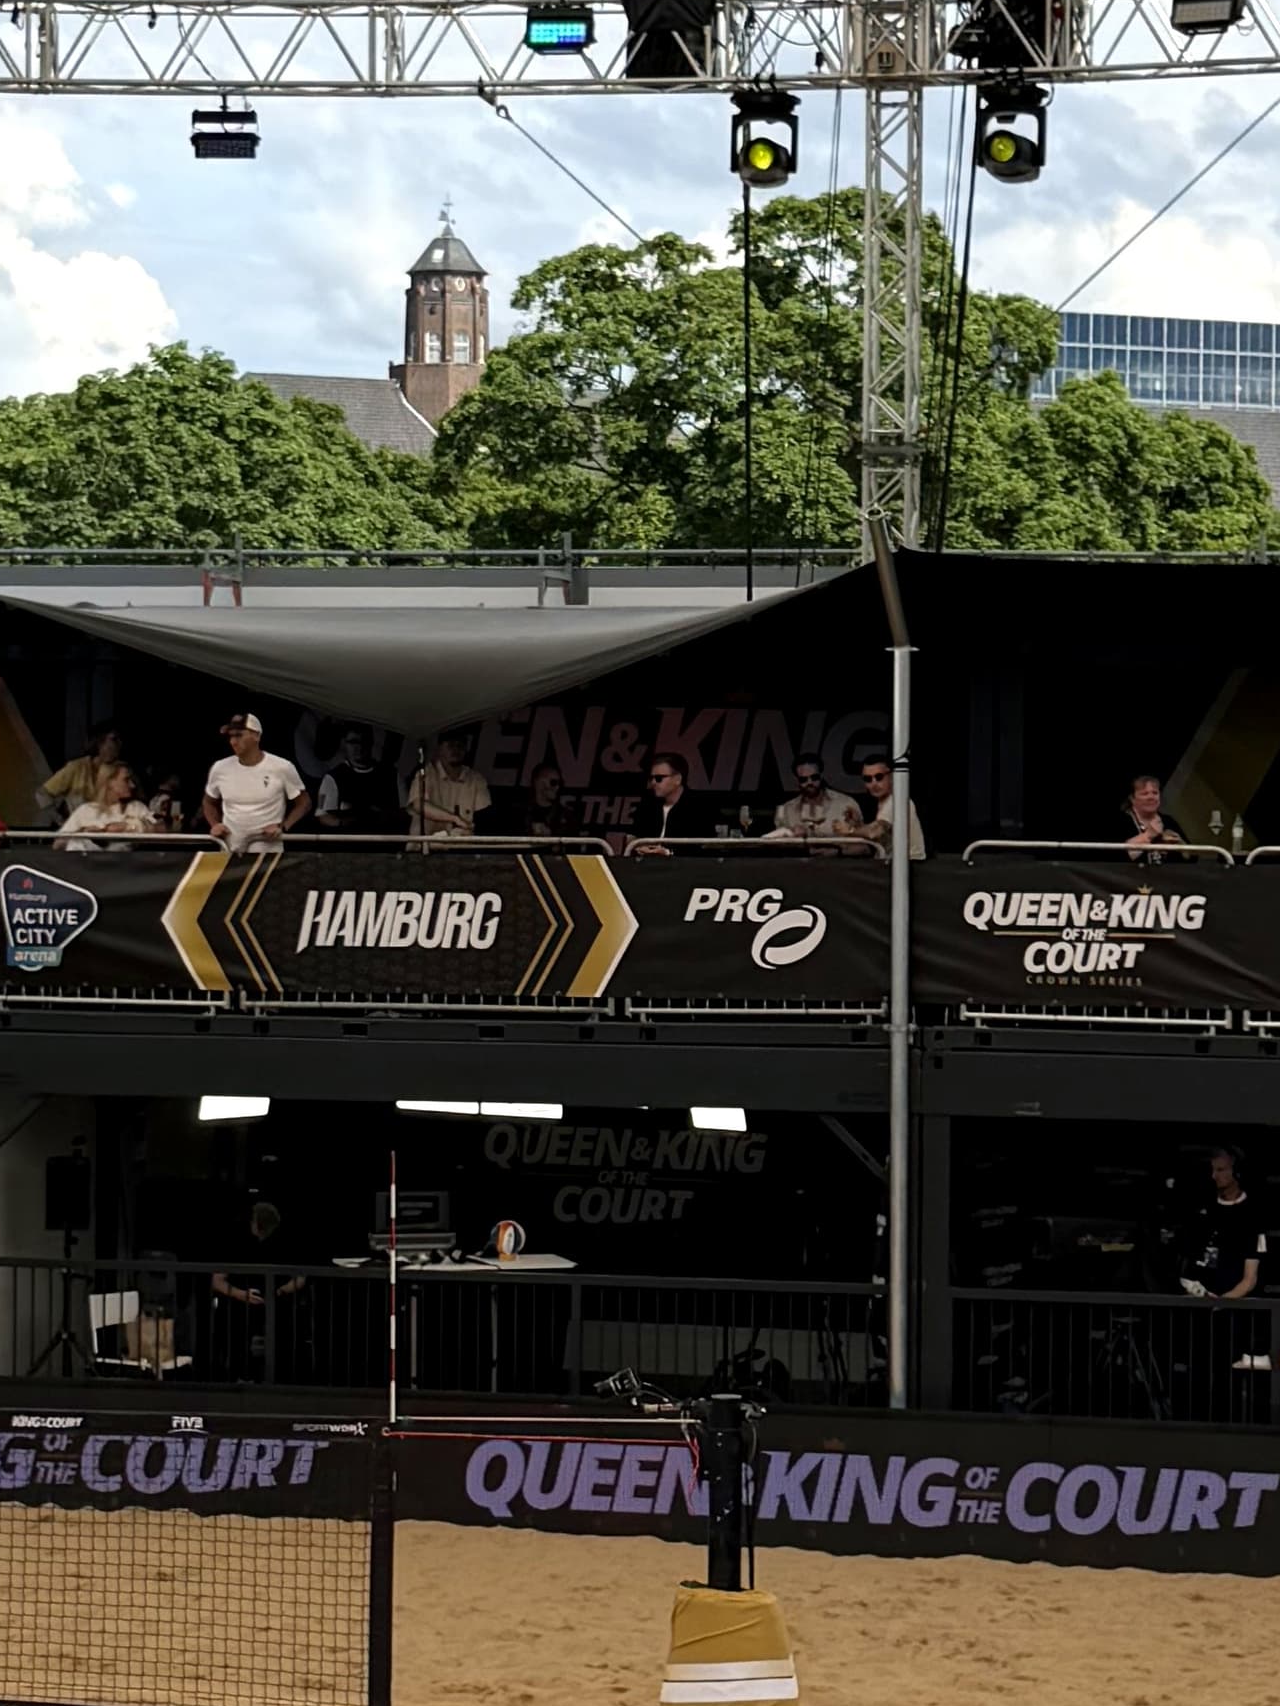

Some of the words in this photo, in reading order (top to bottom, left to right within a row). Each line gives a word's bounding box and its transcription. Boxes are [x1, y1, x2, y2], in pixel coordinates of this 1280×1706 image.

[12, 908, 79, 925] ACTIVE
[296, 889, 503, 954] HAMBURG
[683, 887, 784, 923] PRG
[15, 928, 57, 944] CITY
[1062, 928, 1080, 940] OF
[1082, 929, 1107, 941] THE
[1023, 941, 1145, 974] COURT
[553, 1185, 695, 1224] COURT
[80, 1433, 330, 1493] COURT
[965, 1466, 999, 1490] OF
[956, 1498, 1001, 1525] THE
[1005, 1461, 1280, 1536] COURT
